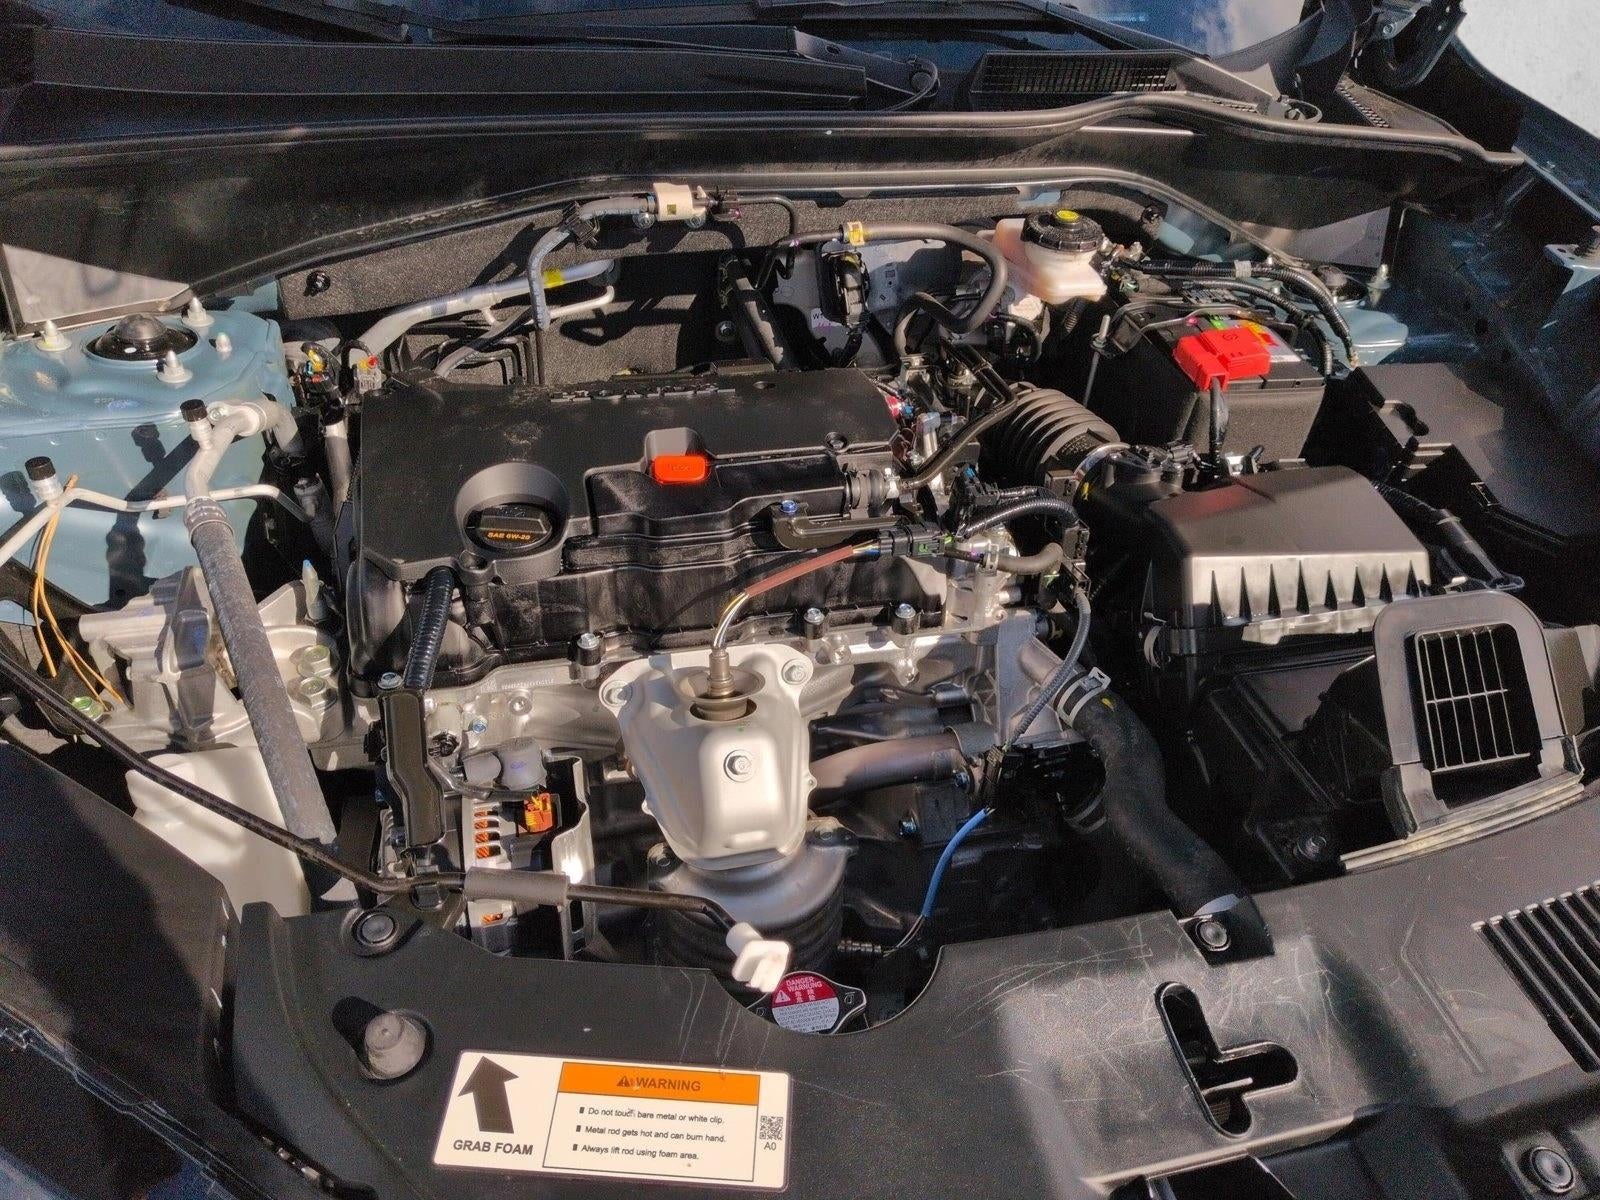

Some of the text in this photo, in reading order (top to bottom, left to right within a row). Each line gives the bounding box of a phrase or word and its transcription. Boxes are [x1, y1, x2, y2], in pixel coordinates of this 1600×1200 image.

[786, 976, 814, 987] DANGER
[636, 1077, 702, 1092] WARNING
[588, 1107, 599, 1115] Do
[601, 1108, 613, 1116] not
[637, 1110, 654, 1119] bare
[656, 1112, 677, 1120] metal
[688, 1115, 708, 1123] white
[709, 1116, 725, 1125] clip.
[585, 1126, 726, 1143] Metal rod gets hot and can burn hand.
[453, 1139, 534, 1155] GRAB FOAM
[581, 1144, 699, 1160] Always lift rod using foam area.
[763, 1141, 777, 1151] A0
